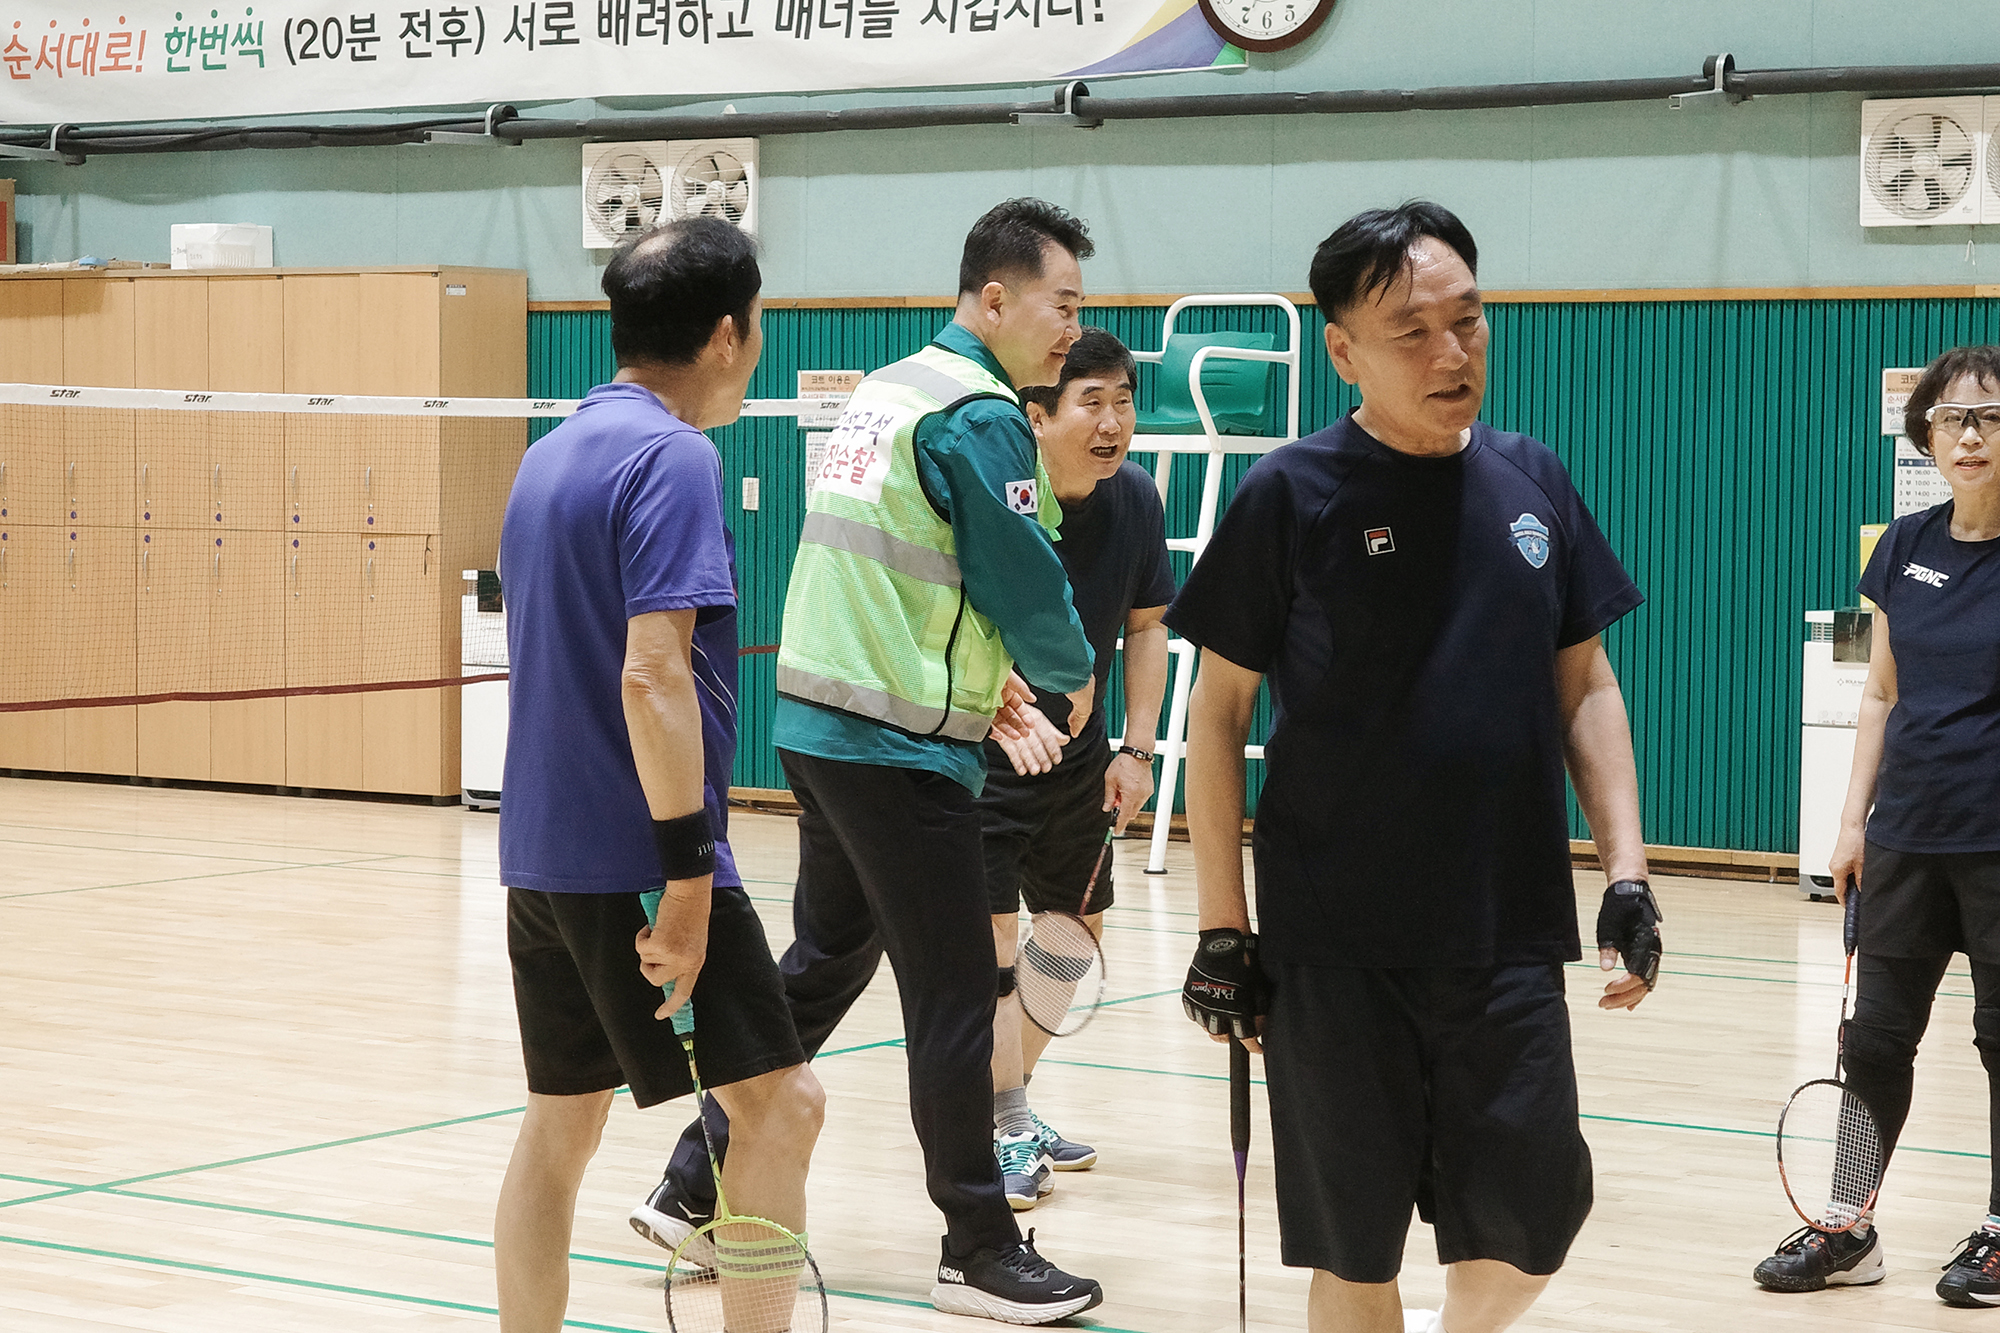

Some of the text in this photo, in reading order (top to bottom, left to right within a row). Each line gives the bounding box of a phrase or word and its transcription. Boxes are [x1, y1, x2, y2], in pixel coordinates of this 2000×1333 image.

[1242, 6, 1250, 24] 7
[1262, 11, 1272, 29] 6
[1285, 4, 1295, 21] 5
[3, 15, 147, 80] 순서대로!
[164, 7, 265, 72] 한번씩
[284, 13, 381, 66] (20분
[399, 5, 485, 58] 전후)
[503, 1, 580, 51] 서로
[598, 0, 754, 46] 배려하고
[775, 0, 900, 40] 매너를
[1902, 561, 1950, 588] PGNC
[938, 1265, 966, 1285] HOKA
